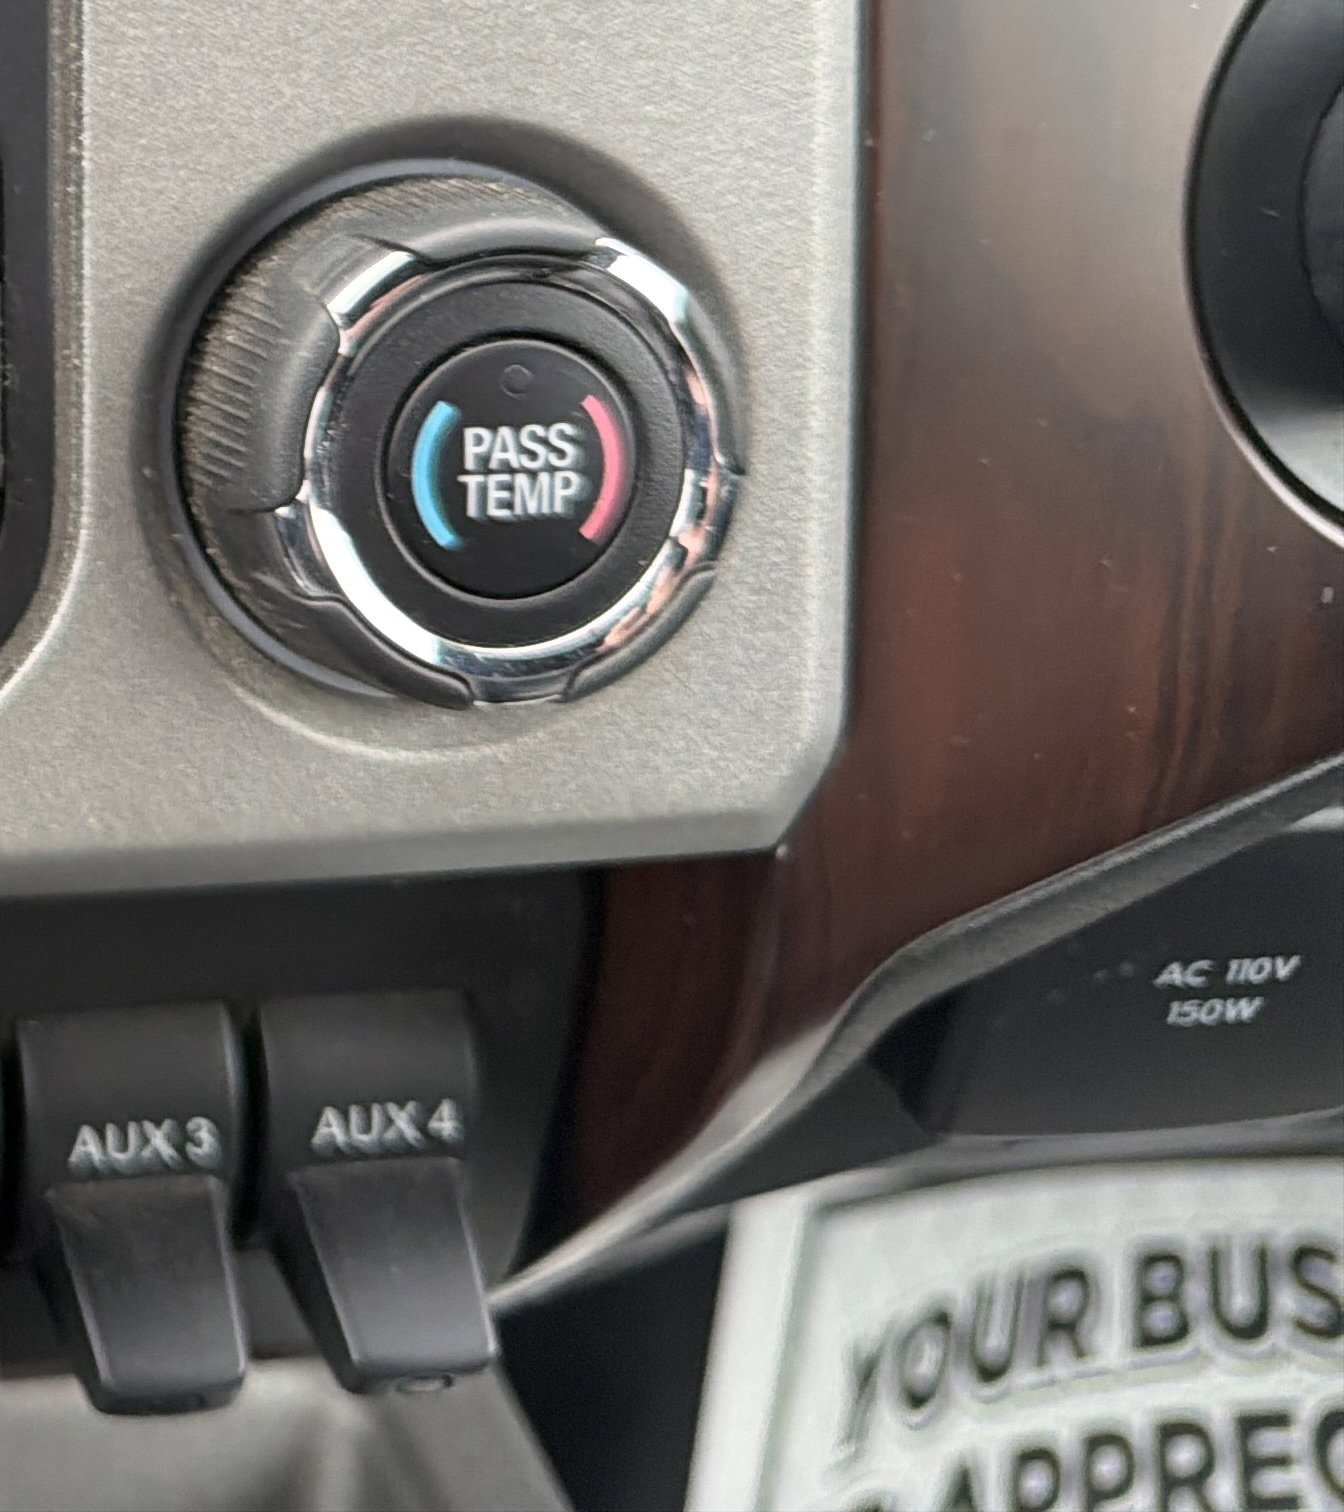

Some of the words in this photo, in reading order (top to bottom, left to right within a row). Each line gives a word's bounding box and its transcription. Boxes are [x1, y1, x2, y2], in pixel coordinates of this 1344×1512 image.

[462, 421, 583, 472] PASS
[457, 471, 585, 521] TEMP
[1153, 958, 1215, 989] AC
[1225, 954, 1302, 986] 110V
[1166, 995, 1265, 1028] 150W
[67, 1118, 182, 1172] AUX
[185, 1114, 221, 1167] 3
[310, 1099, 424, 1154] AUX
[427, 1096, 464, 1143] 4
[842, 1264, 1091, 1454] YOUR
